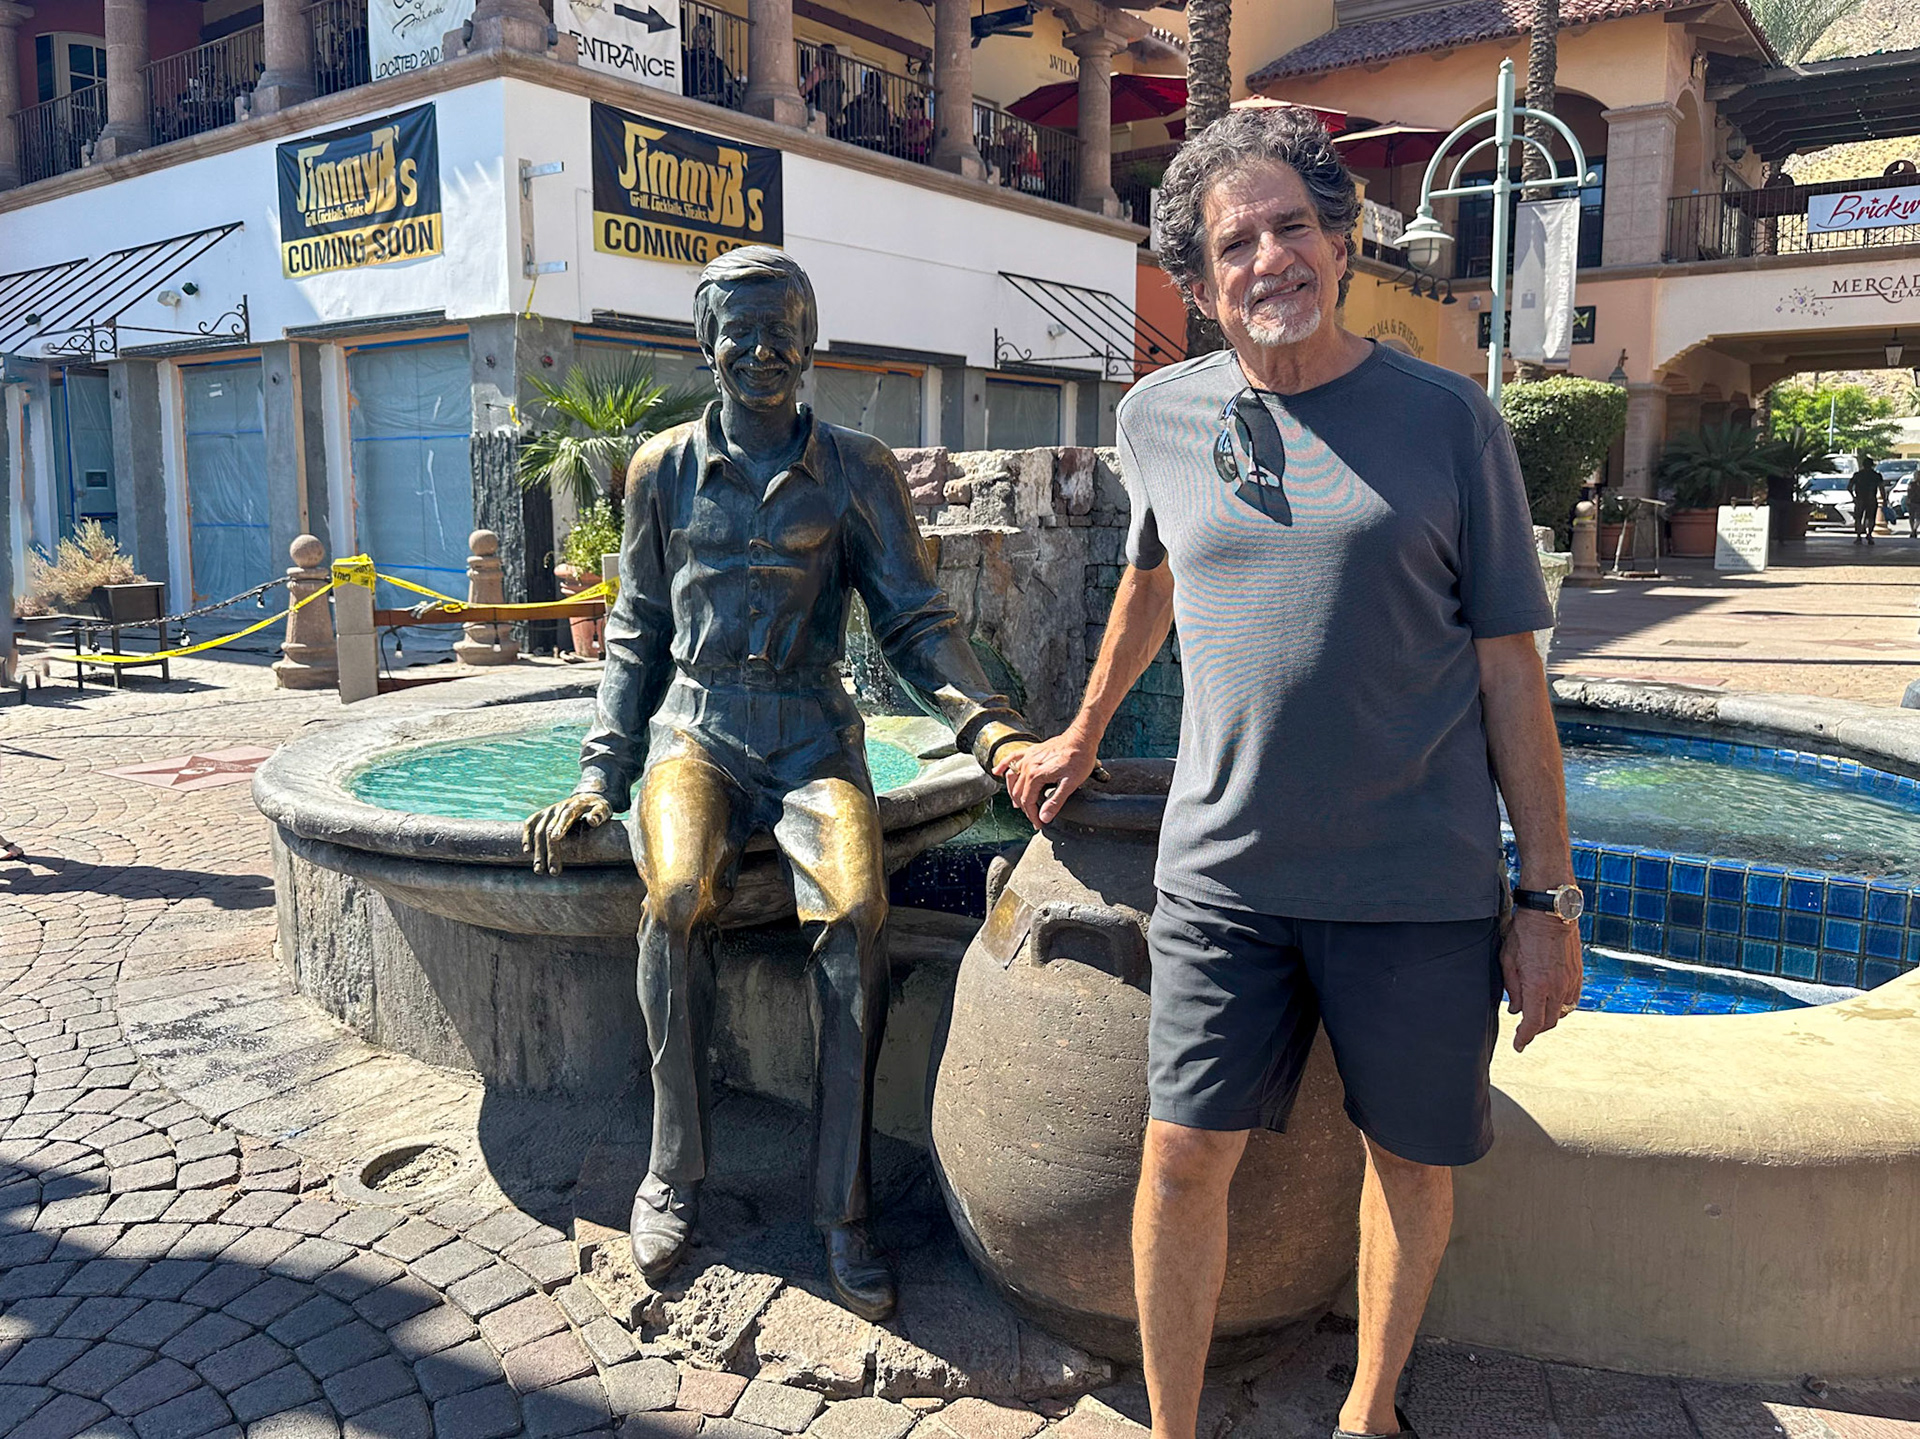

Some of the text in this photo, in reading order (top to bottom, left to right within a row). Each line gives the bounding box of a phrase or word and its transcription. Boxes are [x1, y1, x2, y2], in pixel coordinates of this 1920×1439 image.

[375, 46, 440, 79] LOCATED 2ND
[569, 29, 675, 78] ENTRANCE
[288, 220, 434, 274] COMING SOON
[604, 219, 708, 264] COMING
[1559, 264, 1571, 276] OF
[1557, 277, 1570, 311] VILLAGE
[1391, 319, 1397, 334] &
